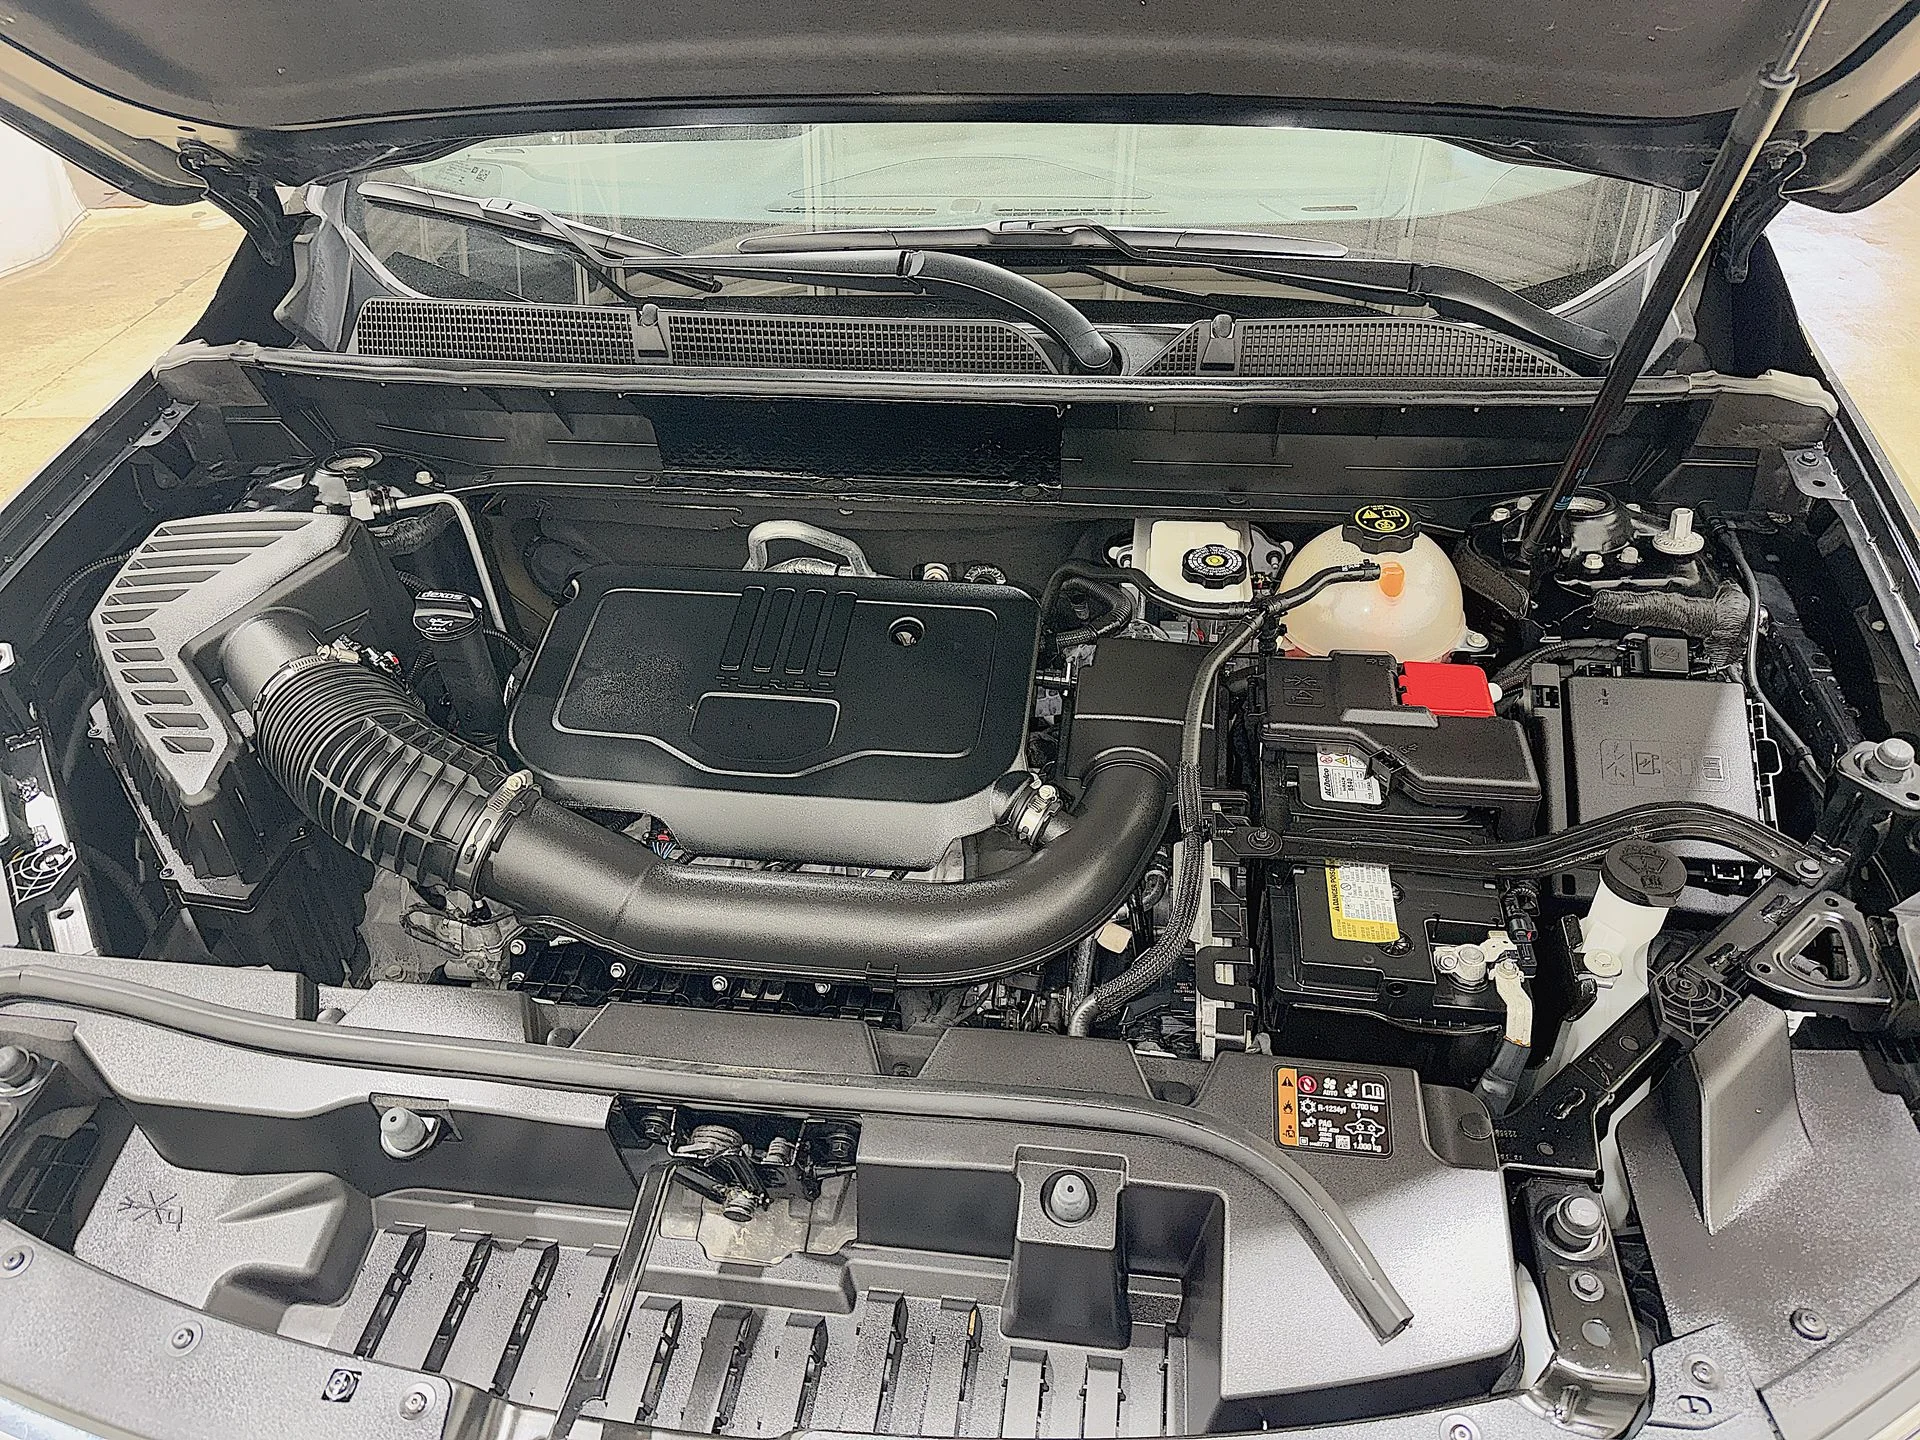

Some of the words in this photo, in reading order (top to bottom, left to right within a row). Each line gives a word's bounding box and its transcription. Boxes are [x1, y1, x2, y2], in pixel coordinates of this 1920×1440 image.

[421, 591, 463, 600] dexos
[715, 676, 835, 693] TURBO
[1323, 768, 1333, 797] ACDelco
[1331, 884, 1339, 905] DANGER
[1318, 1105, 1347, 1114] R-1234yf
[1351, 1102, 1369, 1110] 0.700
[1369, 1104, 1379, 1112] kg
[1318, 1120, 1332, 1128] PAG
[1353, 1142, 1372, 1150] 1.000
[1373, 1143, 1382, 1152] kg
